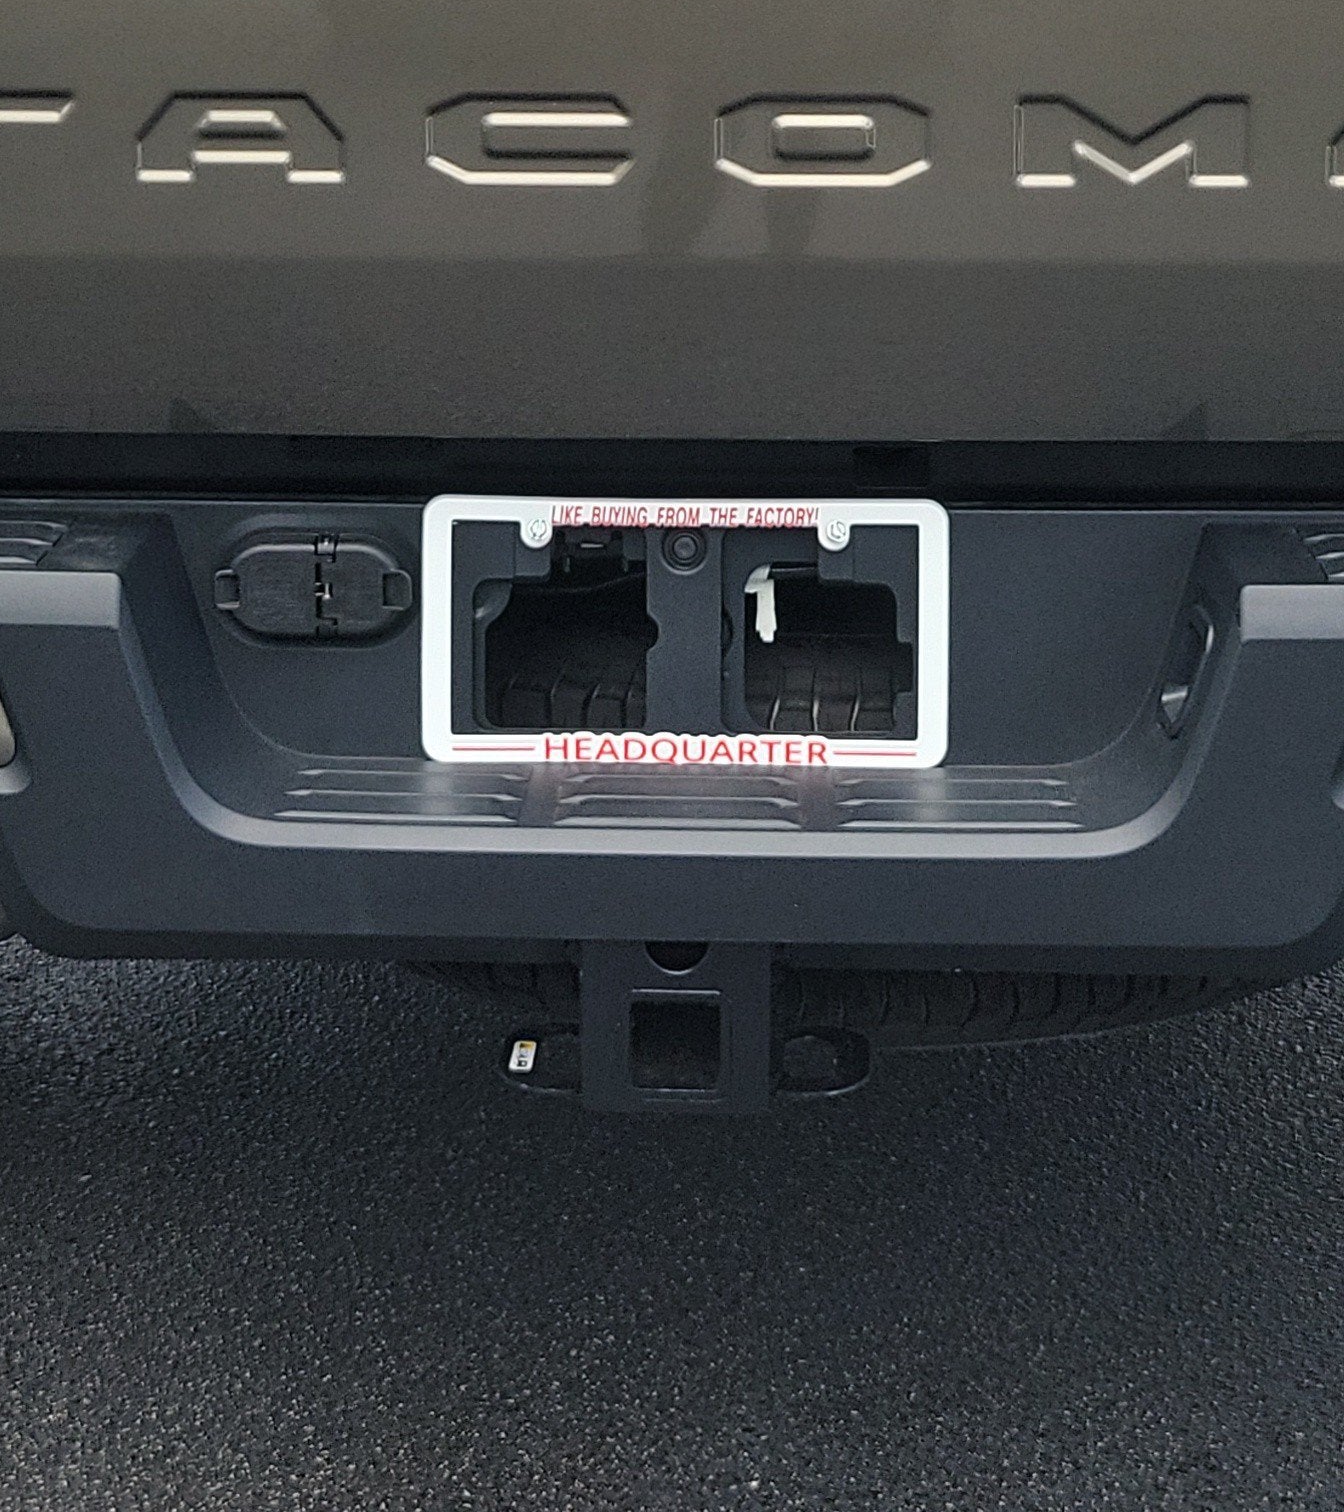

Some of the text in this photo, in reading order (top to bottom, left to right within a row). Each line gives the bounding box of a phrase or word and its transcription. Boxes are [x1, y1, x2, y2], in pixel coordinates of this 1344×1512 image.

[551, 505, 819, 528] LIKE BUYING FROM THE FACTORY!
[544, 737, 828, 765] HEADQUARTER
